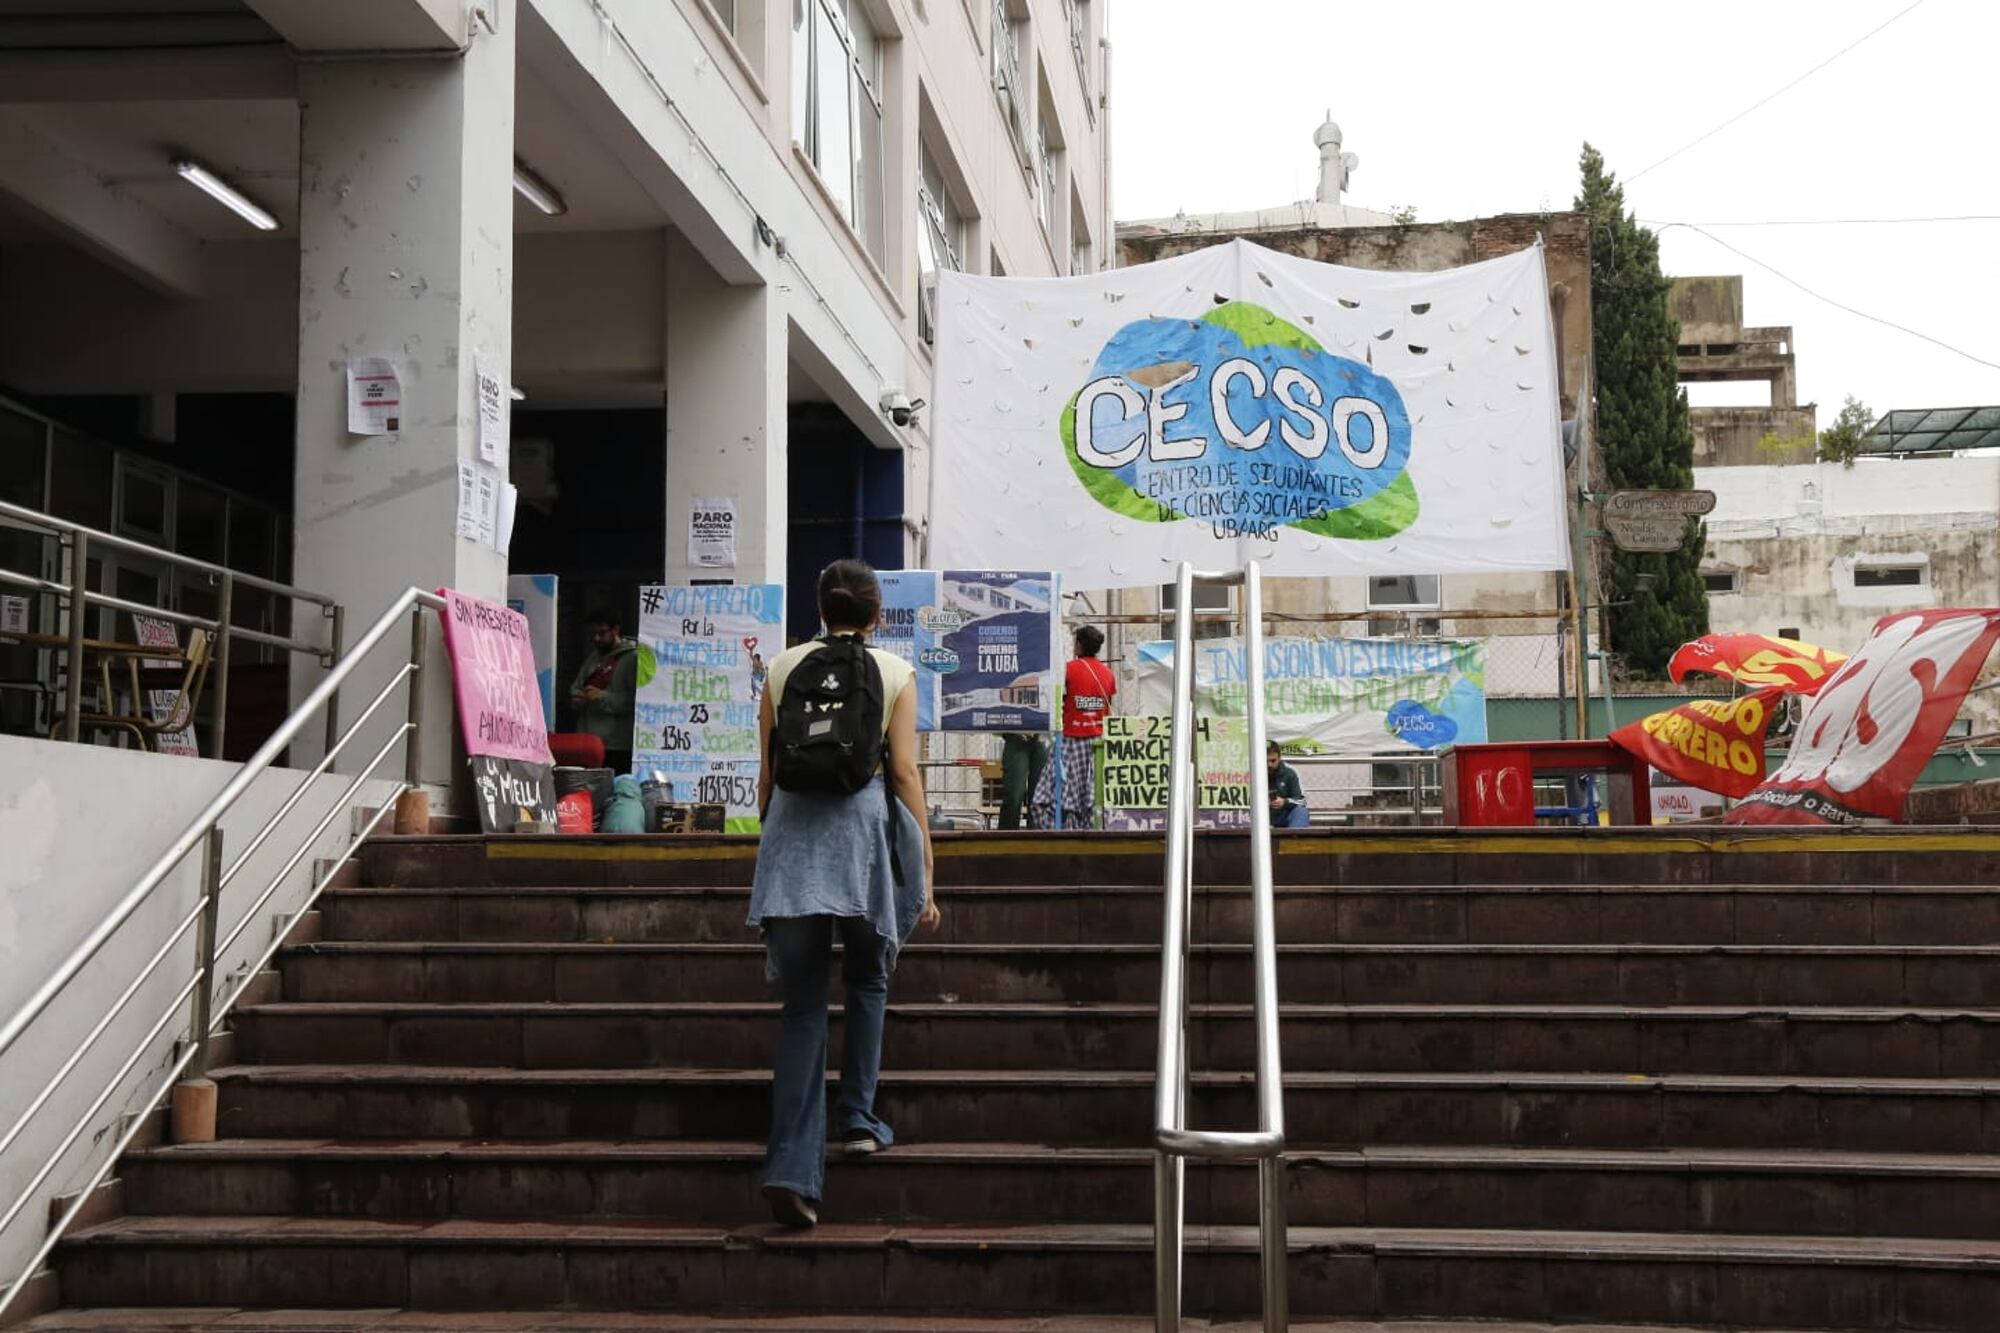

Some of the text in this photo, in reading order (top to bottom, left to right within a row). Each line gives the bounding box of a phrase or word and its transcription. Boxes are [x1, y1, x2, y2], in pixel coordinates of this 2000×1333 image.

[1217, 461, 1240, 486] DE
[693, 512, 732, 522] PARO
[1158, 497, 1179, 522] DE
[455, 598, 474, 625] SIN
[703, 616, 714, 636] la
[978, 644, 1018, 655] CUIDEMOS
[978, 656, 1019, 673] LA UBA
[689, 704, 709, 724] 23
[1108, 717, 1133, 736] EL
[661, 726, 691, 750] 13hs
[1642, 711, 1757, 776] OBRERO
[1106, 740, 1171, 762] MARCH
